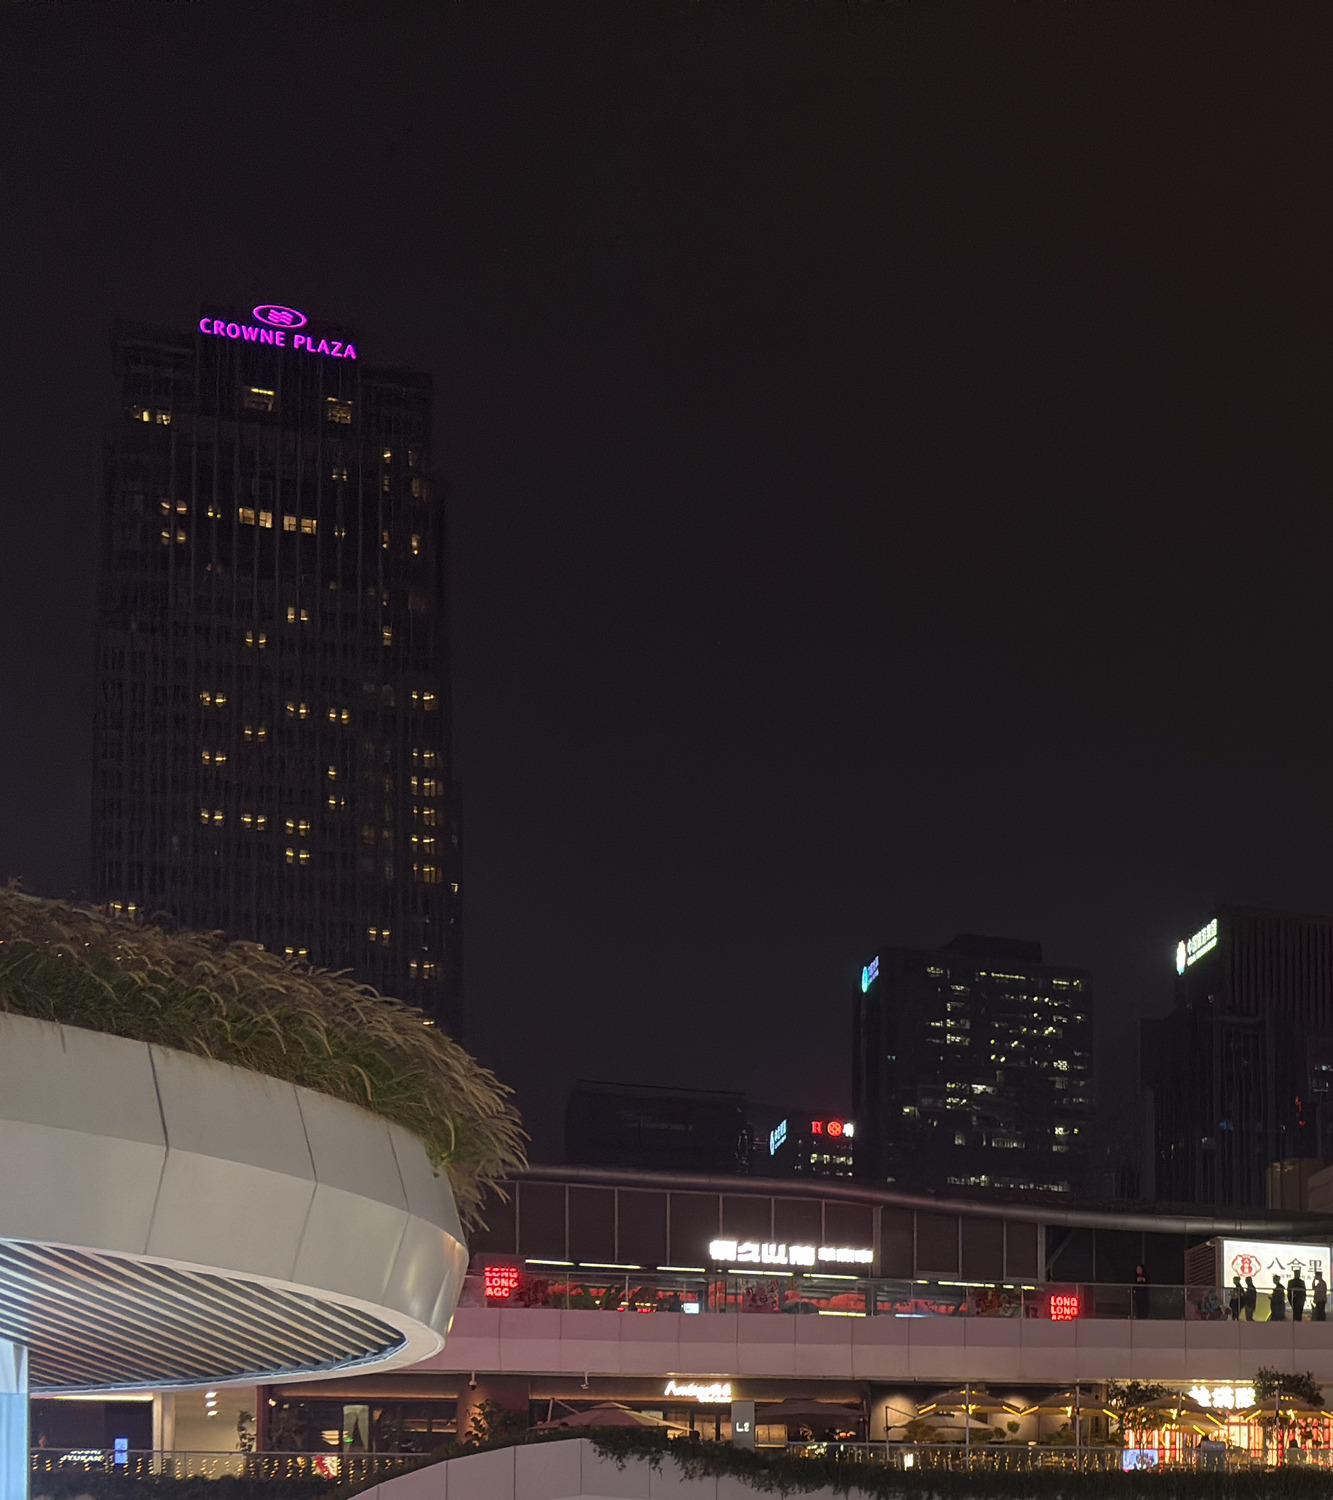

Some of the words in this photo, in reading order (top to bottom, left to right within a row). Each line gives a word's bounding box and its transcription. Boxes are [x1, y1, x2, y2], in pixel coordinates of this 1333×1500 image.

[199, 317, 286, 347] CROWNE
[293, 334, 357, 360] PLAZA
[1267, 1257, 1323, 1274] 八合里
[484, 1277, 520, 1288] LONG
[735, 1421, 750, 1433] L2
